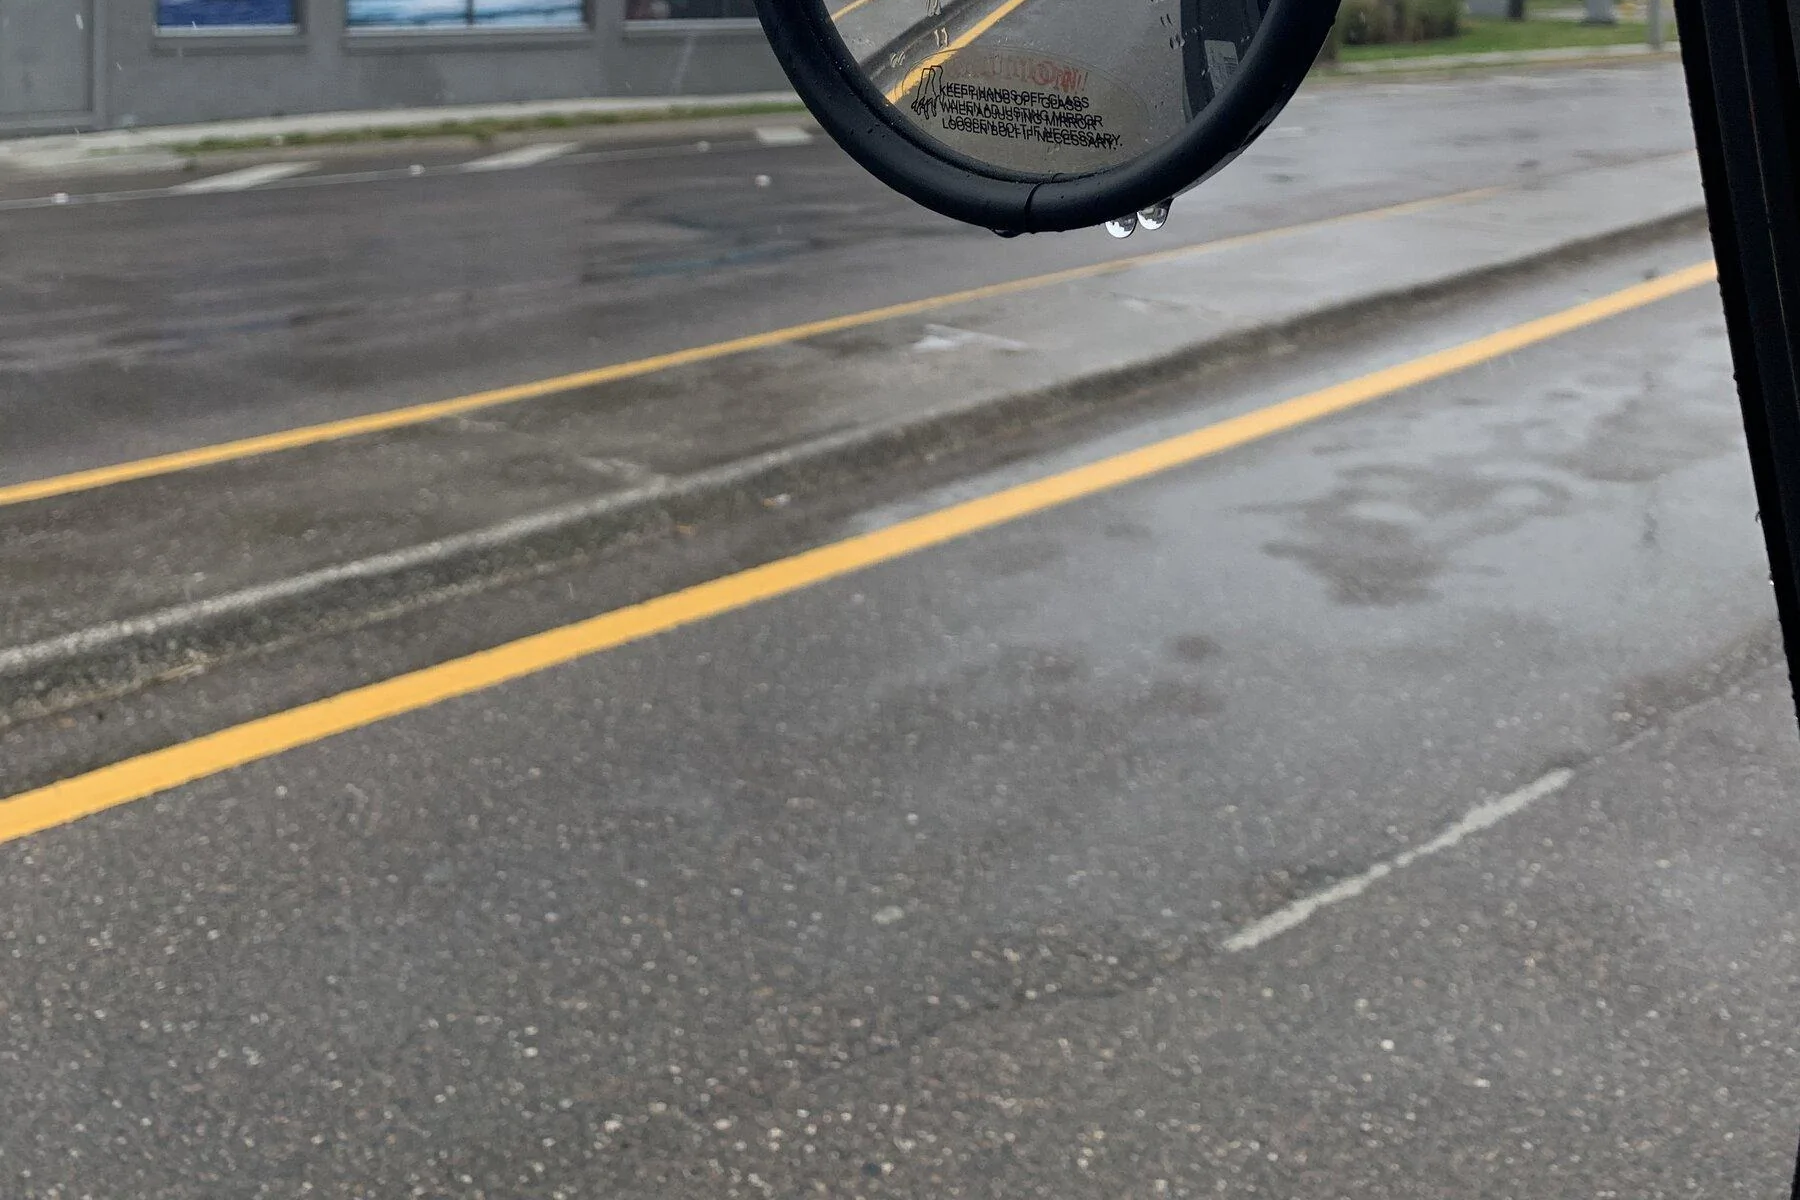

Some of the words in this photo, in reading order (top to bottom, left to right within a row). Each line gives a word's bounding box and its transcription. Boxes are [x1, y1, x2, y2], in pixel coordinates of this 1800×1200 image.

[940, 82, 976, 99] KEEP
[972, 86, 1017, 104] HANDS
[1015, 91, 1044, 106] OFF
[1042, 94, 1090, 112] GLASS
[941, 98, 978, 116] WHEN
[977, 103, 1048, 124] ADJUSTING
[1046, 111, 1103, 130] MIRROR
[942, 115, 994, 134] LOOSEN
[992, 122, 1026, 139] BOLT
